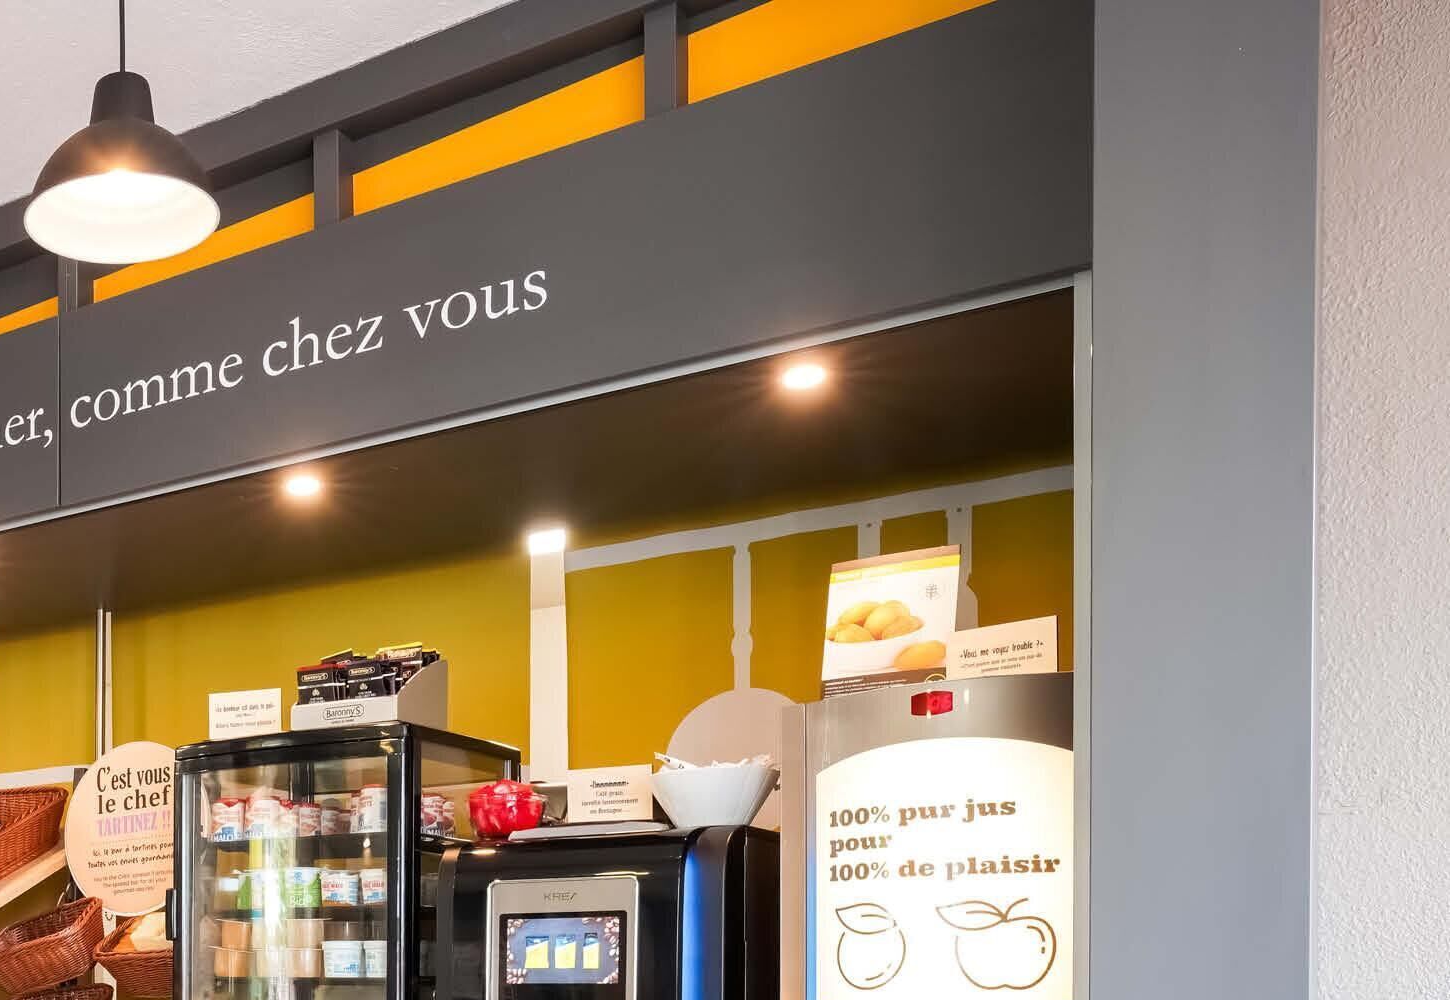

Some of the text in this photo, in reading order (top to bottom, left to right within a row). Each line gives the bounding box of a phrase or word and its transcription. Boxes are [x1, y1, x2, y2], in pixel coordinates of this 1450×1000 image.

[69, 353, 244, 429] comme
[261, 314, 384, 377] chez
[403, 269, 549, 339] vous
[96, 766, 171, 792] C'est vous
[98, 784, 171, 814] le chef
[830, 799, 1017, 827] 100% pur jus
[96, 812, 157, 837] TARTINEZ
[830, 835, 893, 858] pour
[830, 854, 1061, 882] 100% de plaisir
